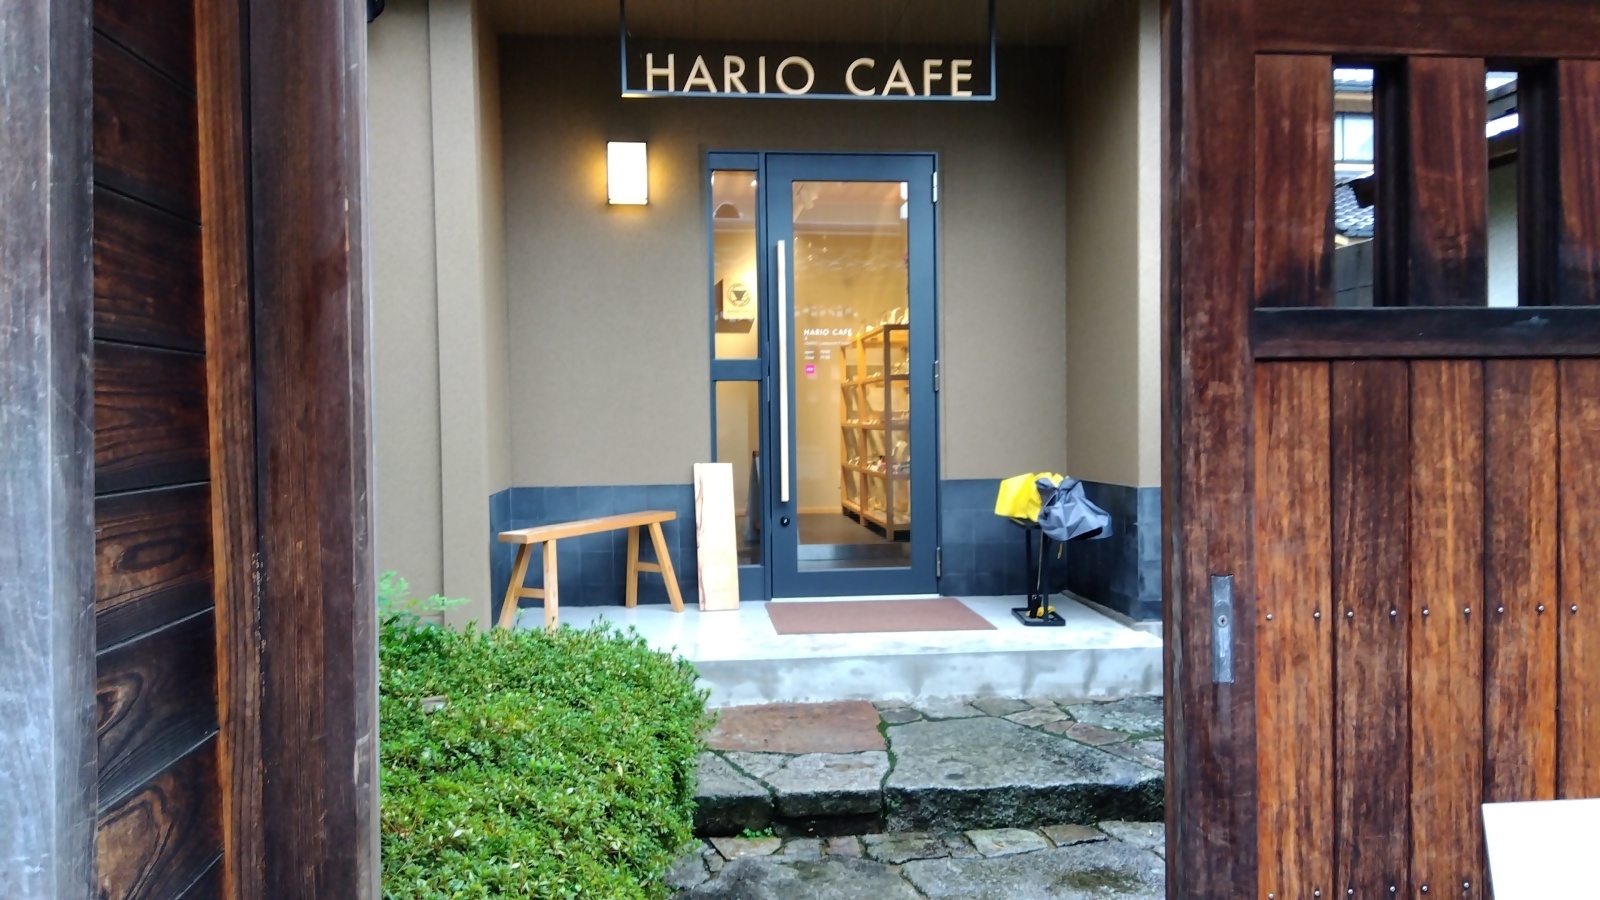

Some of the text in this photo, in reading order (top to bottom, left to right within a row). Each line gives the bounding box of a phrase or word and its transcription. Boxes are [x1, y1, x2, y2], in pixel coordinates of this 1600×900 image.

[646, 53, 973, 97] HARIO CAFE
[804, 328, 852, 336] HARIO CAFE
